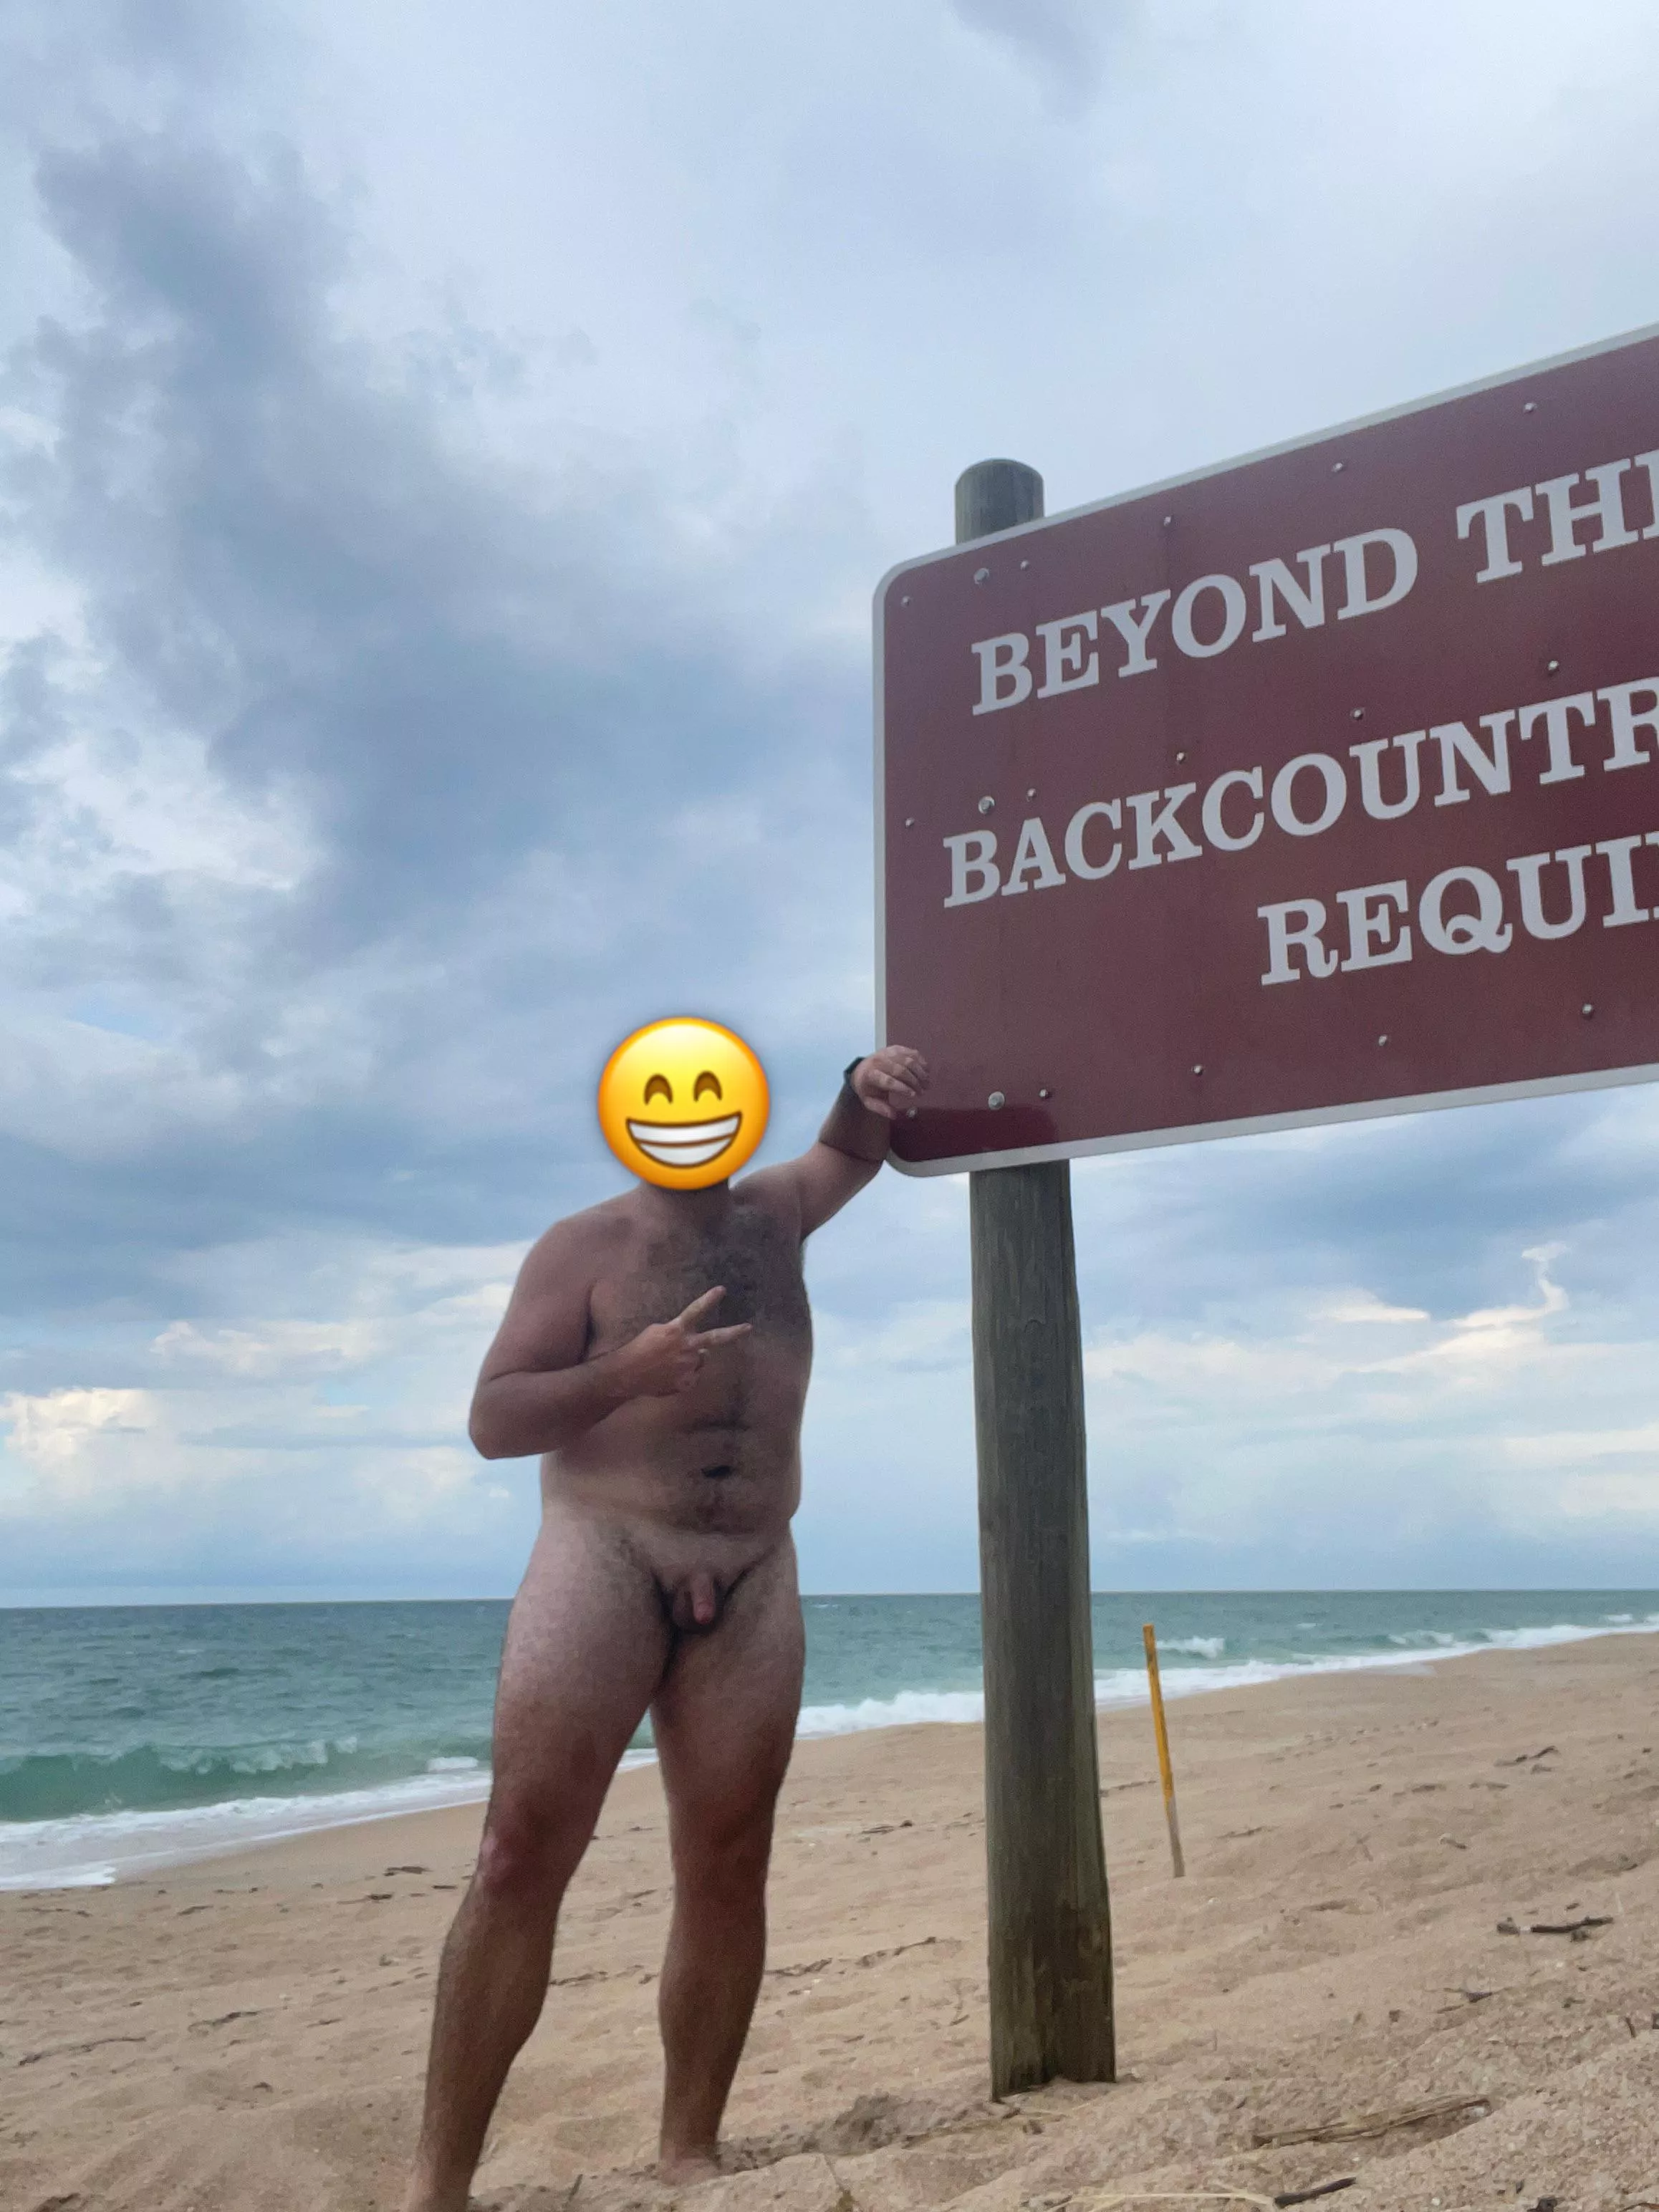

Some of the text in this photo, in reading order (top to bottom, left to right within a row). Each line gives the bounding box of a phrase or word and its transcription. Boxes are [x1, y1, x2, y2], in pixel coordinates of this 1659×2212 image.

[972, 529, 1418, 715] BEYOND
[943, 677, 1659, 908] BACKCOUNTR
[1258, 832, 1659, 985] REQUI
